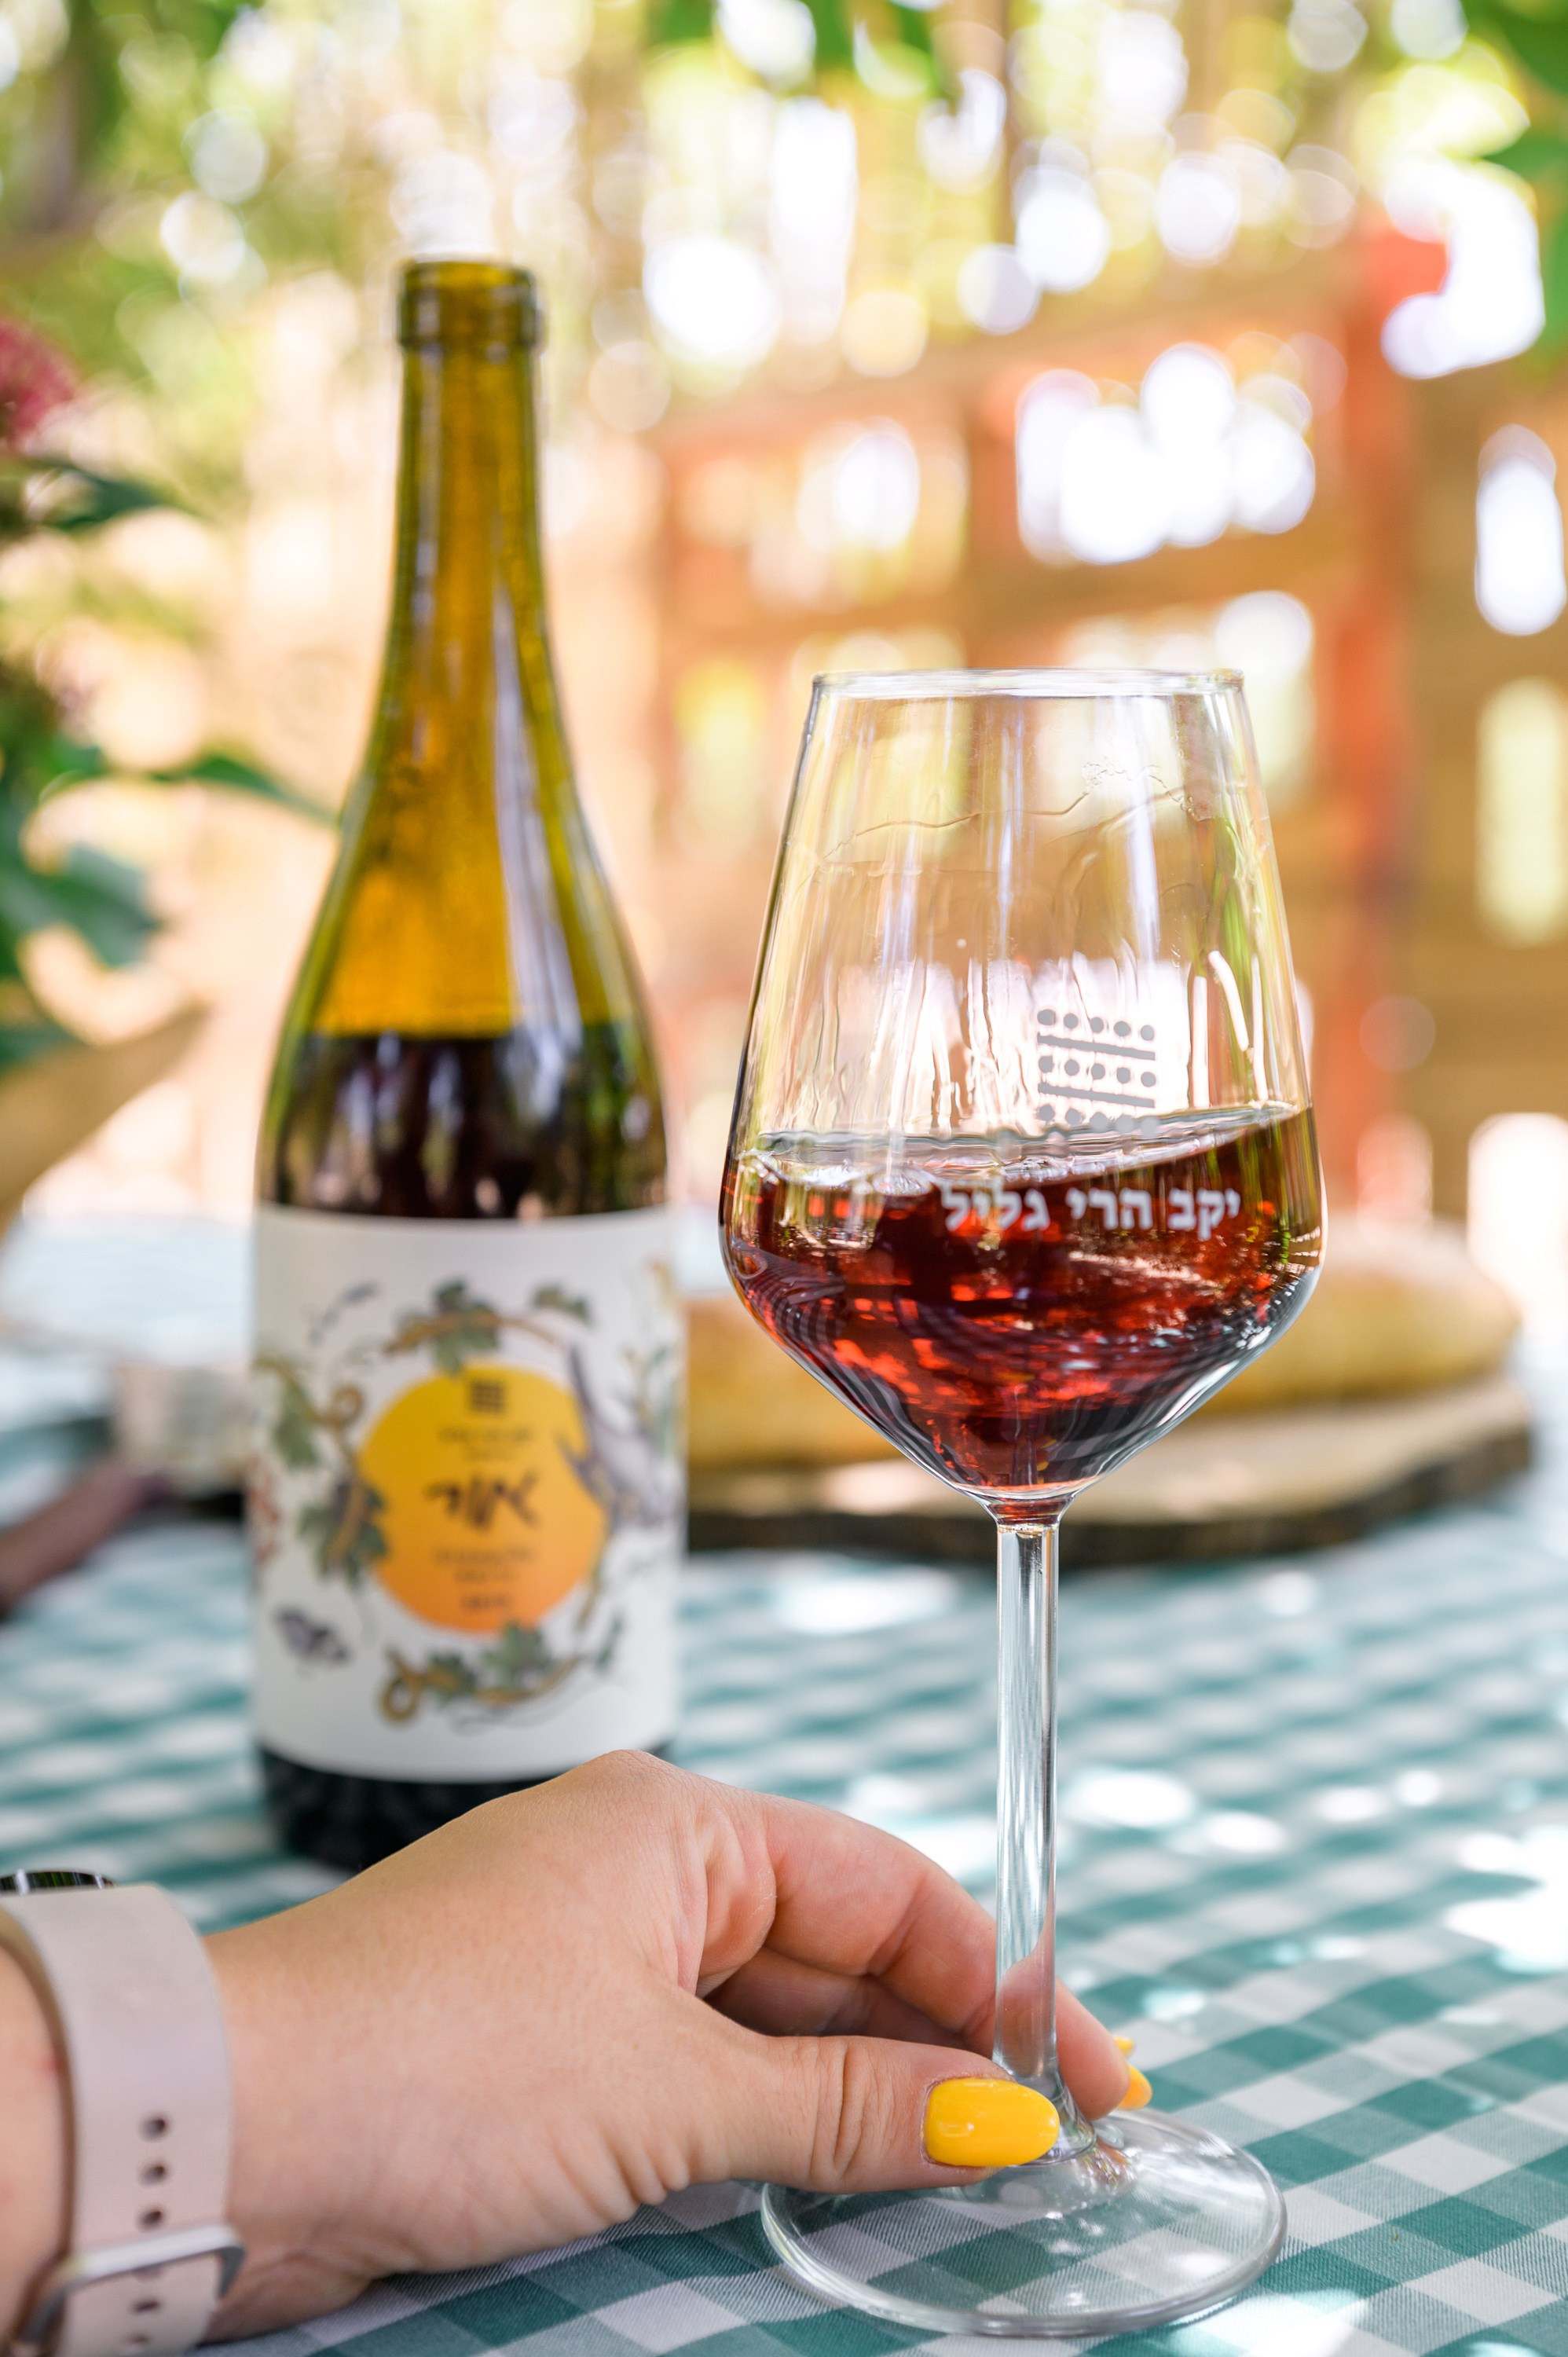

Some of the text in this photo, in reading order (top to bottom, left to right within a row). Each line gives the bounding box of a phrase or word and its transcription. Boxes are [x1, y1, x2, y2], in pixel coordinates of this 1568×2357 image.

[941, 1178, 1241, 1241] יקב הרי גליל
